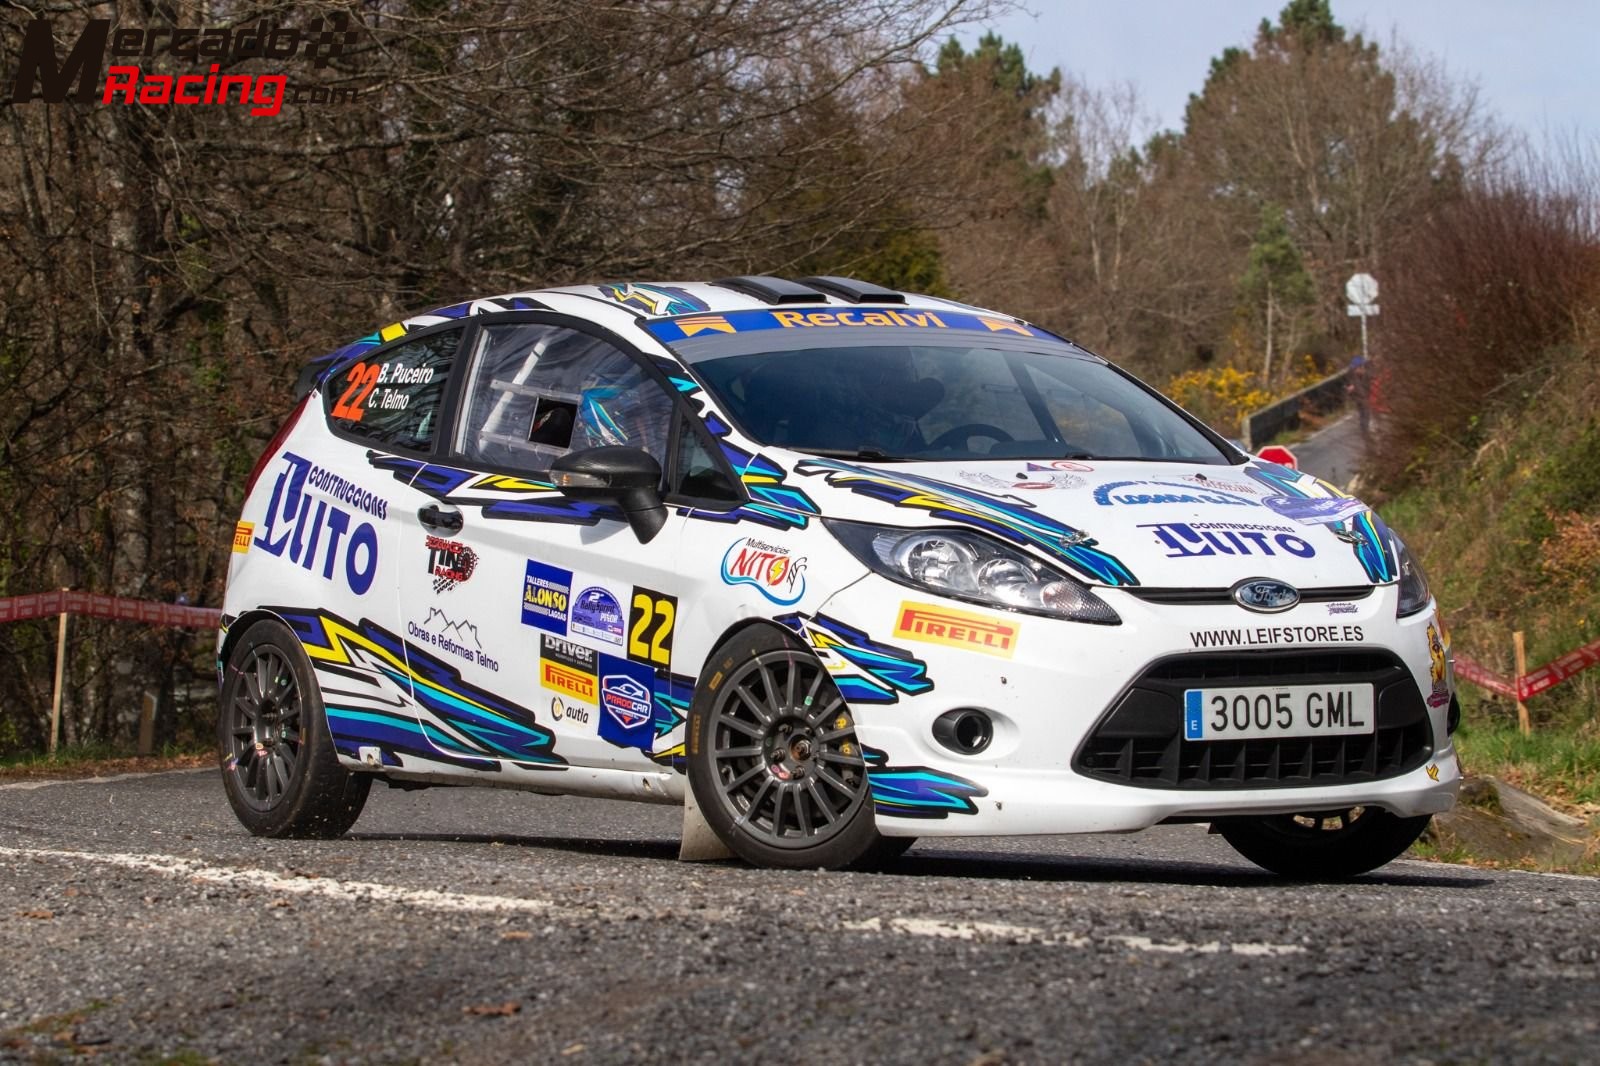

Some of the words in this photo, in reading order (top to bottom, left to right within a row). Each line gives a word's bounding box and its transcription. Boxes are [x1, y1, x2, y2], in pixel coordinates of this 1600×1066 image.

[770, 310, 949, 328] Recalvi
[377, 363, 389, 384] B.
[390, 363, 434, 384] Puceiro
[331, 362, 380, 421] 22
[368, 388, 379, 408] C.
[381, 388, 410, 410] Telmo
[308, 465, 388, 521] CONSTRUCCIONES
[730, 547, 789, 586] NITO
[524, 584, 567, 611] ALONSO
[1253, 584, 1294, 602] Ford
[630, 593, 675, 665] 22
[900, 608, 1015, 650] PIRELLI
[1190, 625, 1364, 648] WWW.LEIFSTORE.ES
[408, 621, 430, 643] Obras
[431, 634, 437, 645] e
[438, 633, 474, 662] Reformas
[475, 649, 499, 672] Telmo
[545, 664, 593, 697] PIRELLI
[606, 693, 649, 714] PRADOCAR
[1210, 693, 1293, 732] 3005
[1306, 690, 1365, 729] GML
[566, 706, 589, 729] autia
[1191, 719, 1198, 731] E
